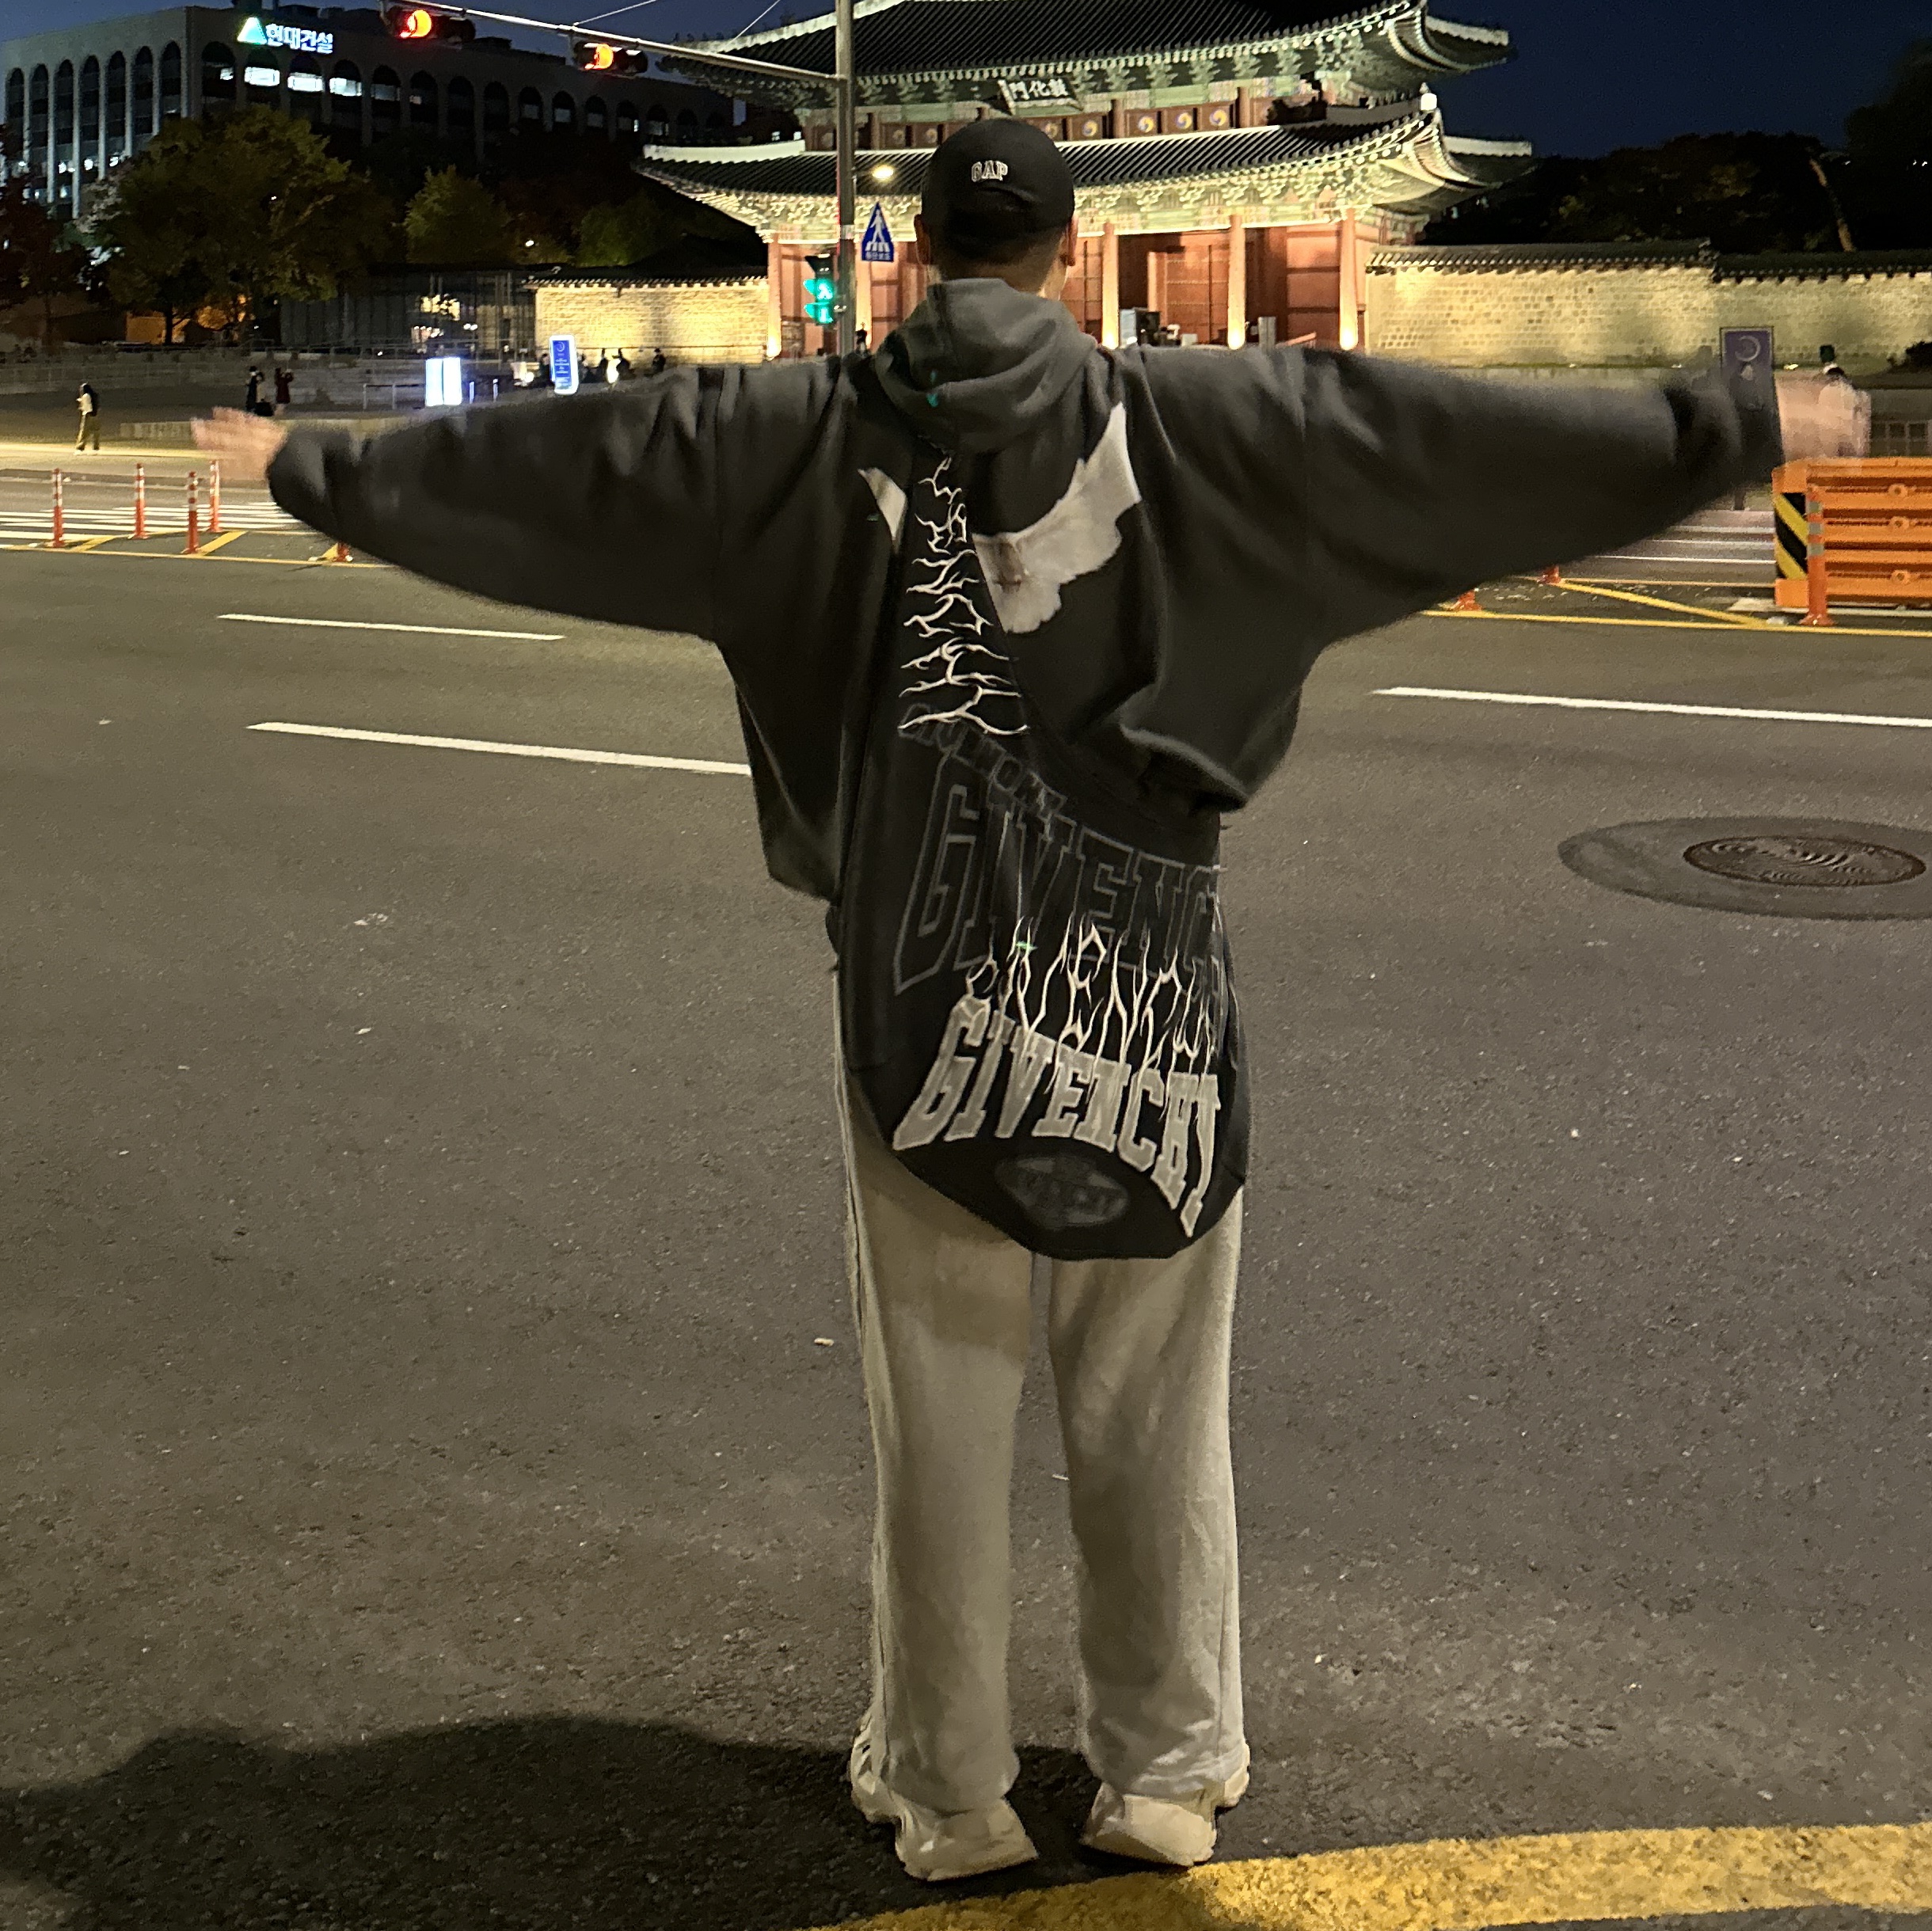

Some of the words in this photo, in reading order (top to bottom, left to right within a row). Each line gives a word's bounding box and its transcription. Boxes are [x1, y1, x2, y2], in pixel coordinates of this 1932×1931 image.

[265, 23, 333, 54] 현대건설
[971, 160, 1008, 182] GAP
[892, 994, 1221, 1237] GIVENCHY
